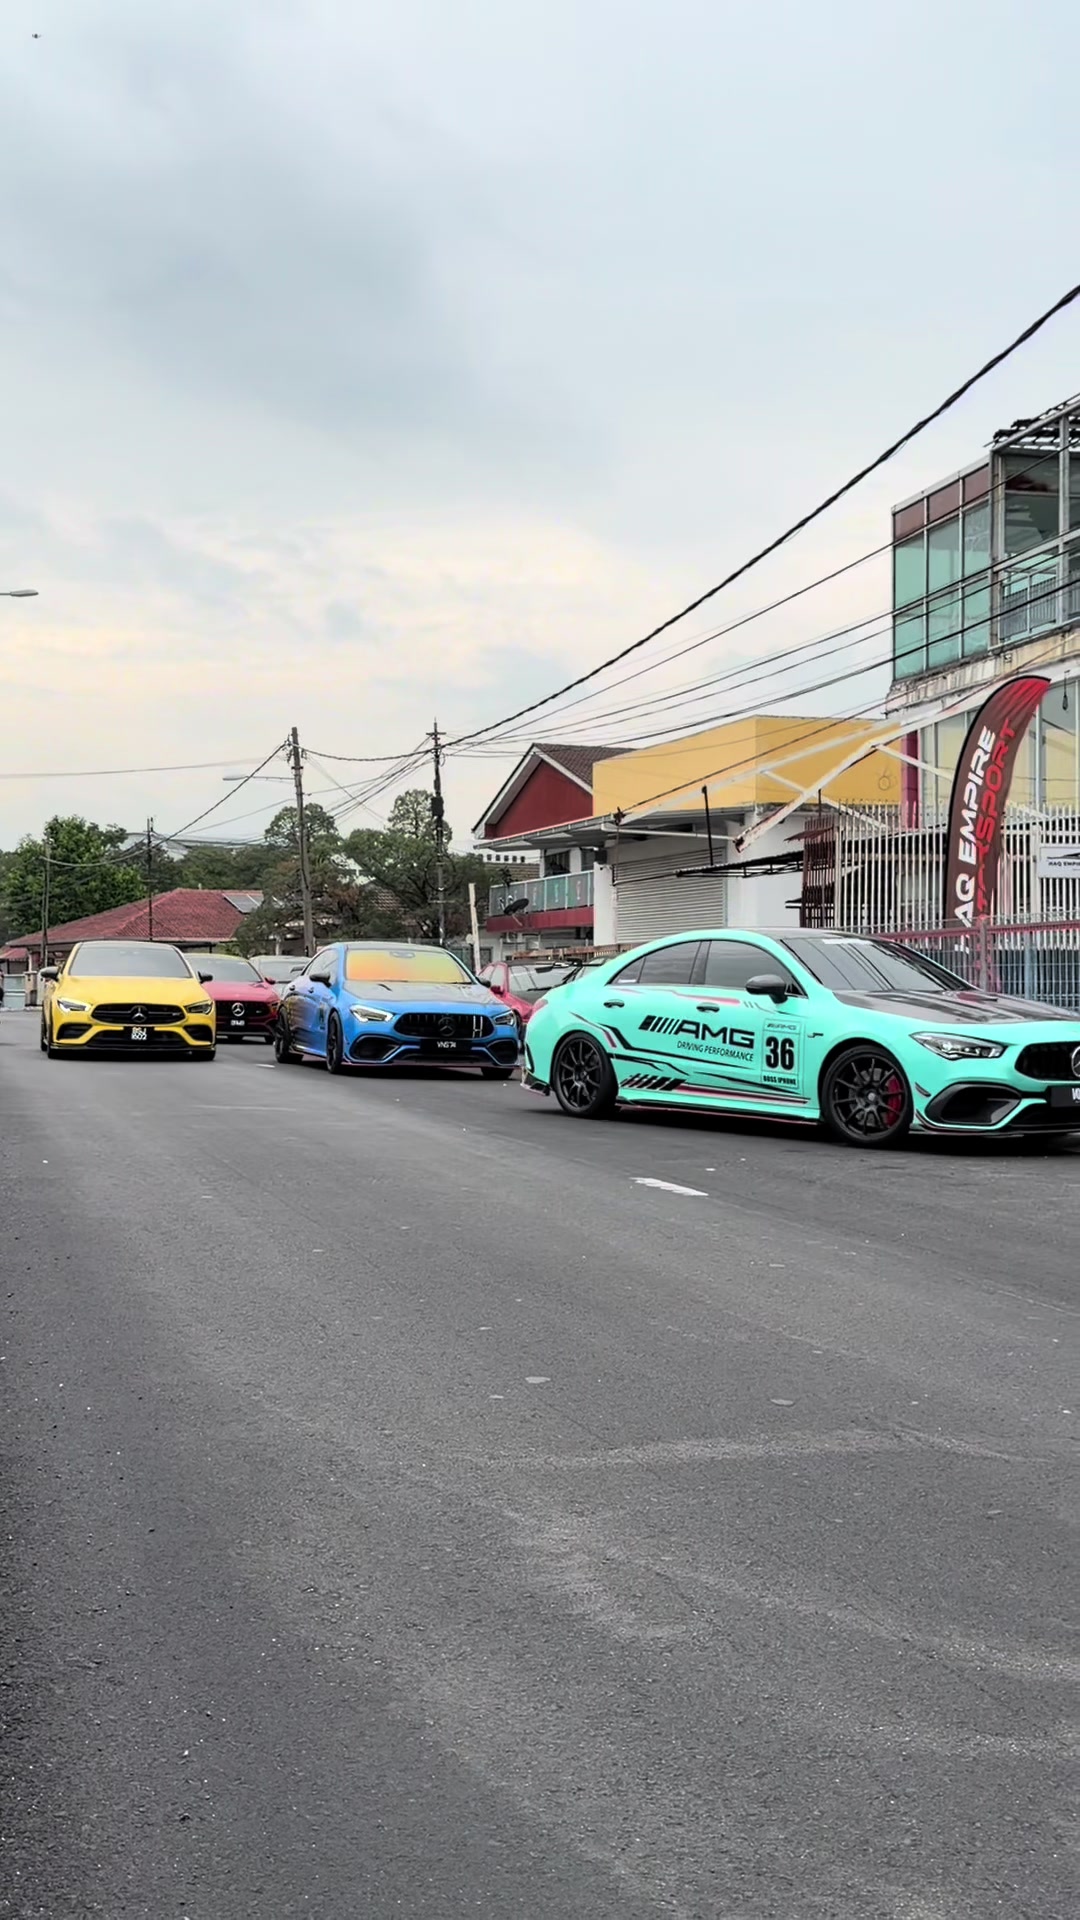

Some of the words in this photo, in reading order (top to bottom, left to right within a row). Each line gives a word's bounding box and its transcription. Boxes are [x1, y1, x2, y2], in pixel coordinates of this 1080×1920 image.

[958, 725, 996, 865] EMPIRE
[673, 1019, 755, 1049] AMG
[677, 1040, 704, 1053] DRIVING
[704, 1045, 754, 1062] PERFORMANCE
[765, 1035, 795, 1071] 36
